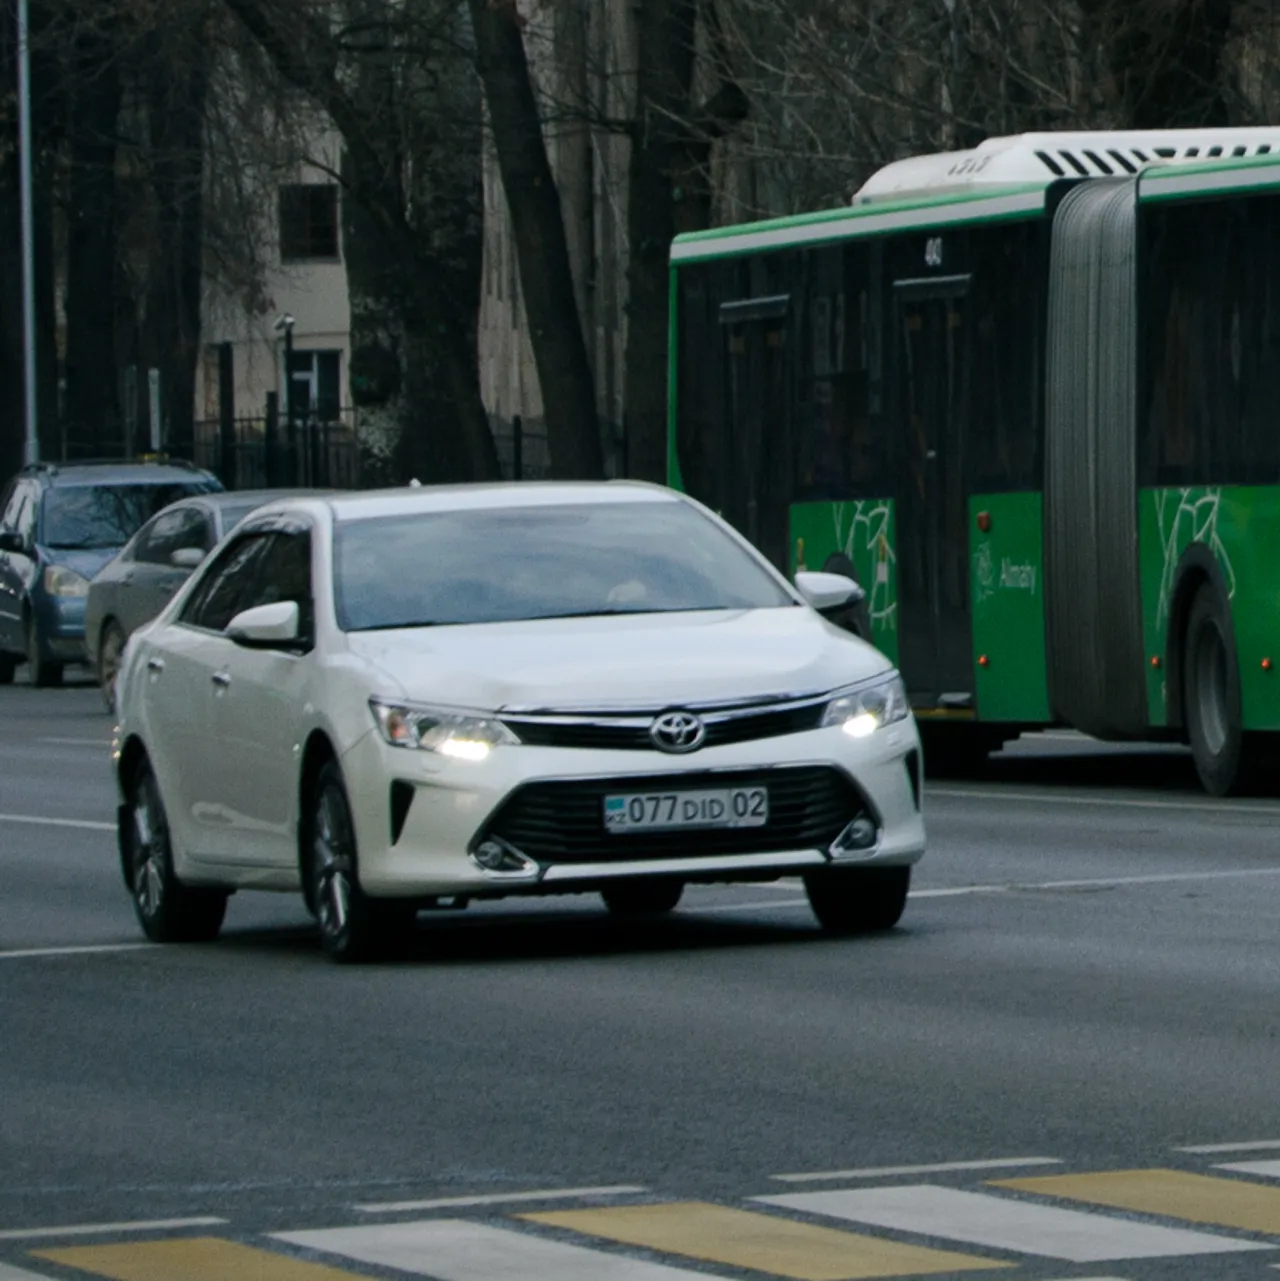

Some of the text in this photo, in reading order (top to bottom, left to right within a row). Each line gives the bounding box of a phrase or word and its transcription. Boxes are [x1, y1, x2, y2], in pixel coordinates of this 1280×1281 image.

[628, 794, 678, 823] 077
[682, 798, 726, 821] DID
[732, 790, 766, 818] 02
